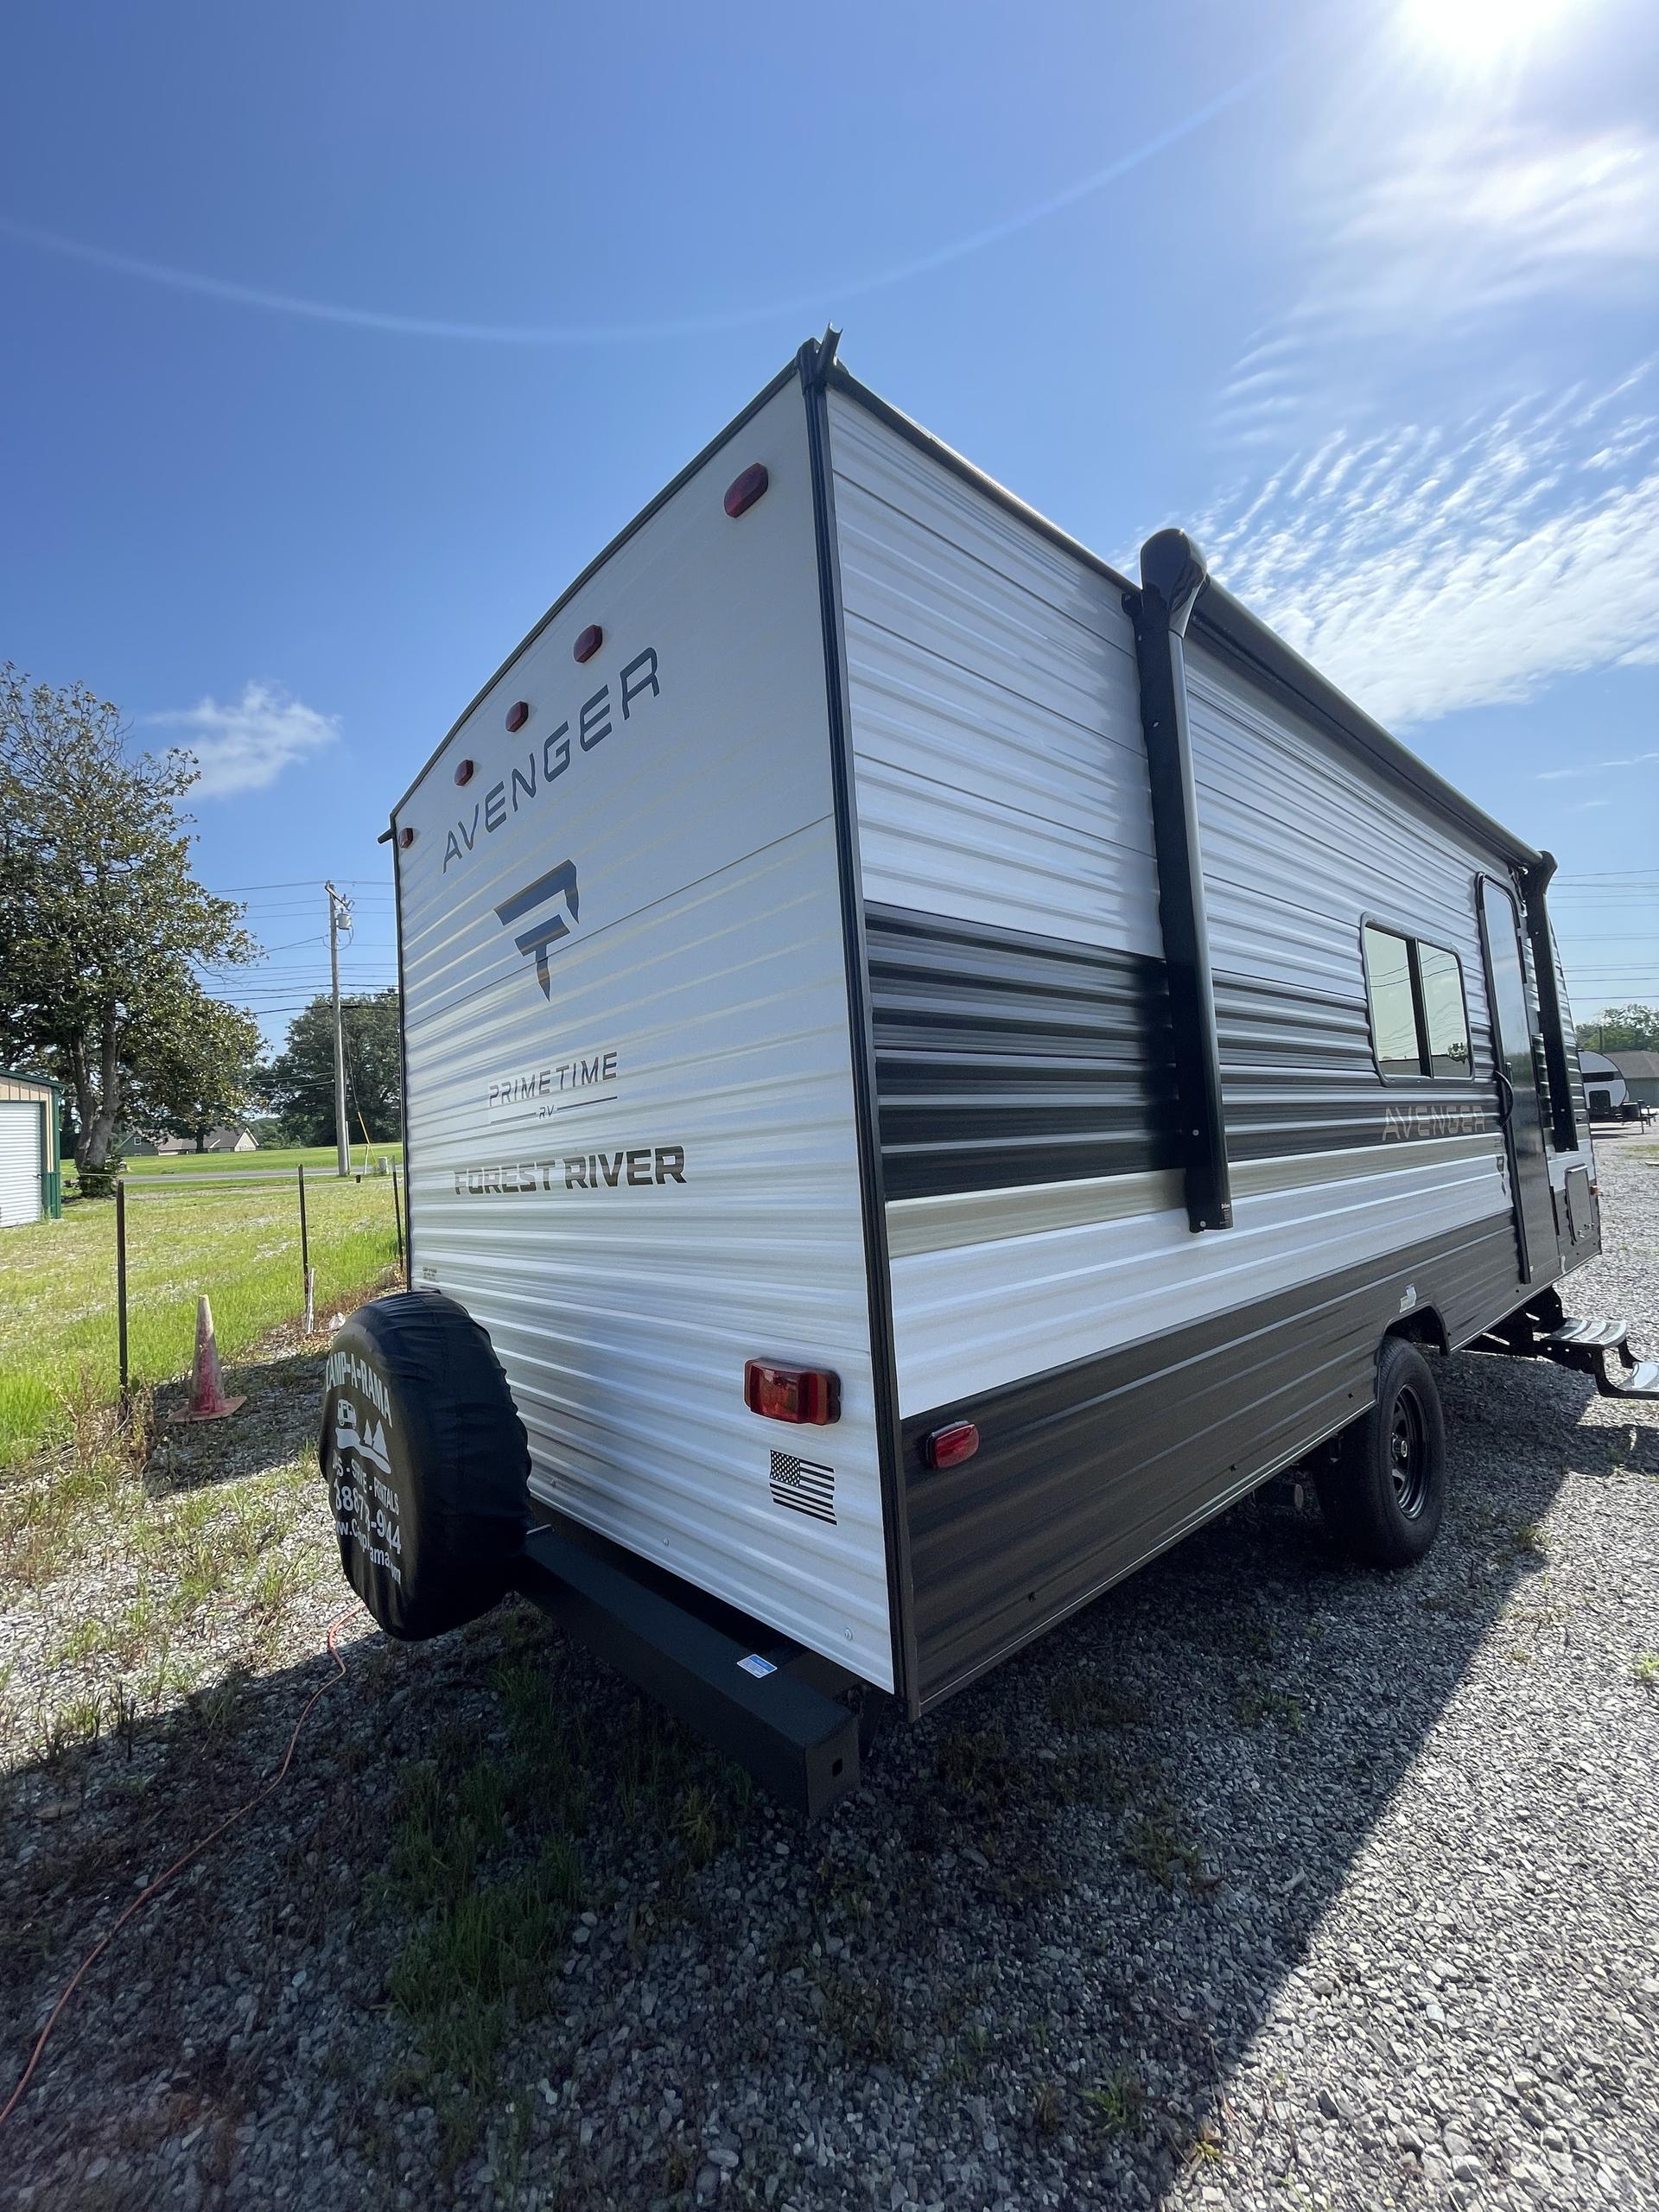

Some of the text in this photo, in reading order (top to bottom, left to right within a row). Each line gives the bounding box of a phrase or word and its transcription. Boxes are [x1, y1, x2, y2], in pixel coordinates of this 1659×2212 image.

[443, 647, 660, 874] AVENGER
[538, 1103, 556, 1119] RV
[1382, 1104, 1485, 1141] AVENGER
[454, 1145, 687, 1195] FOREST RIVER
[374, 1476, 400, 1516] RTALS
